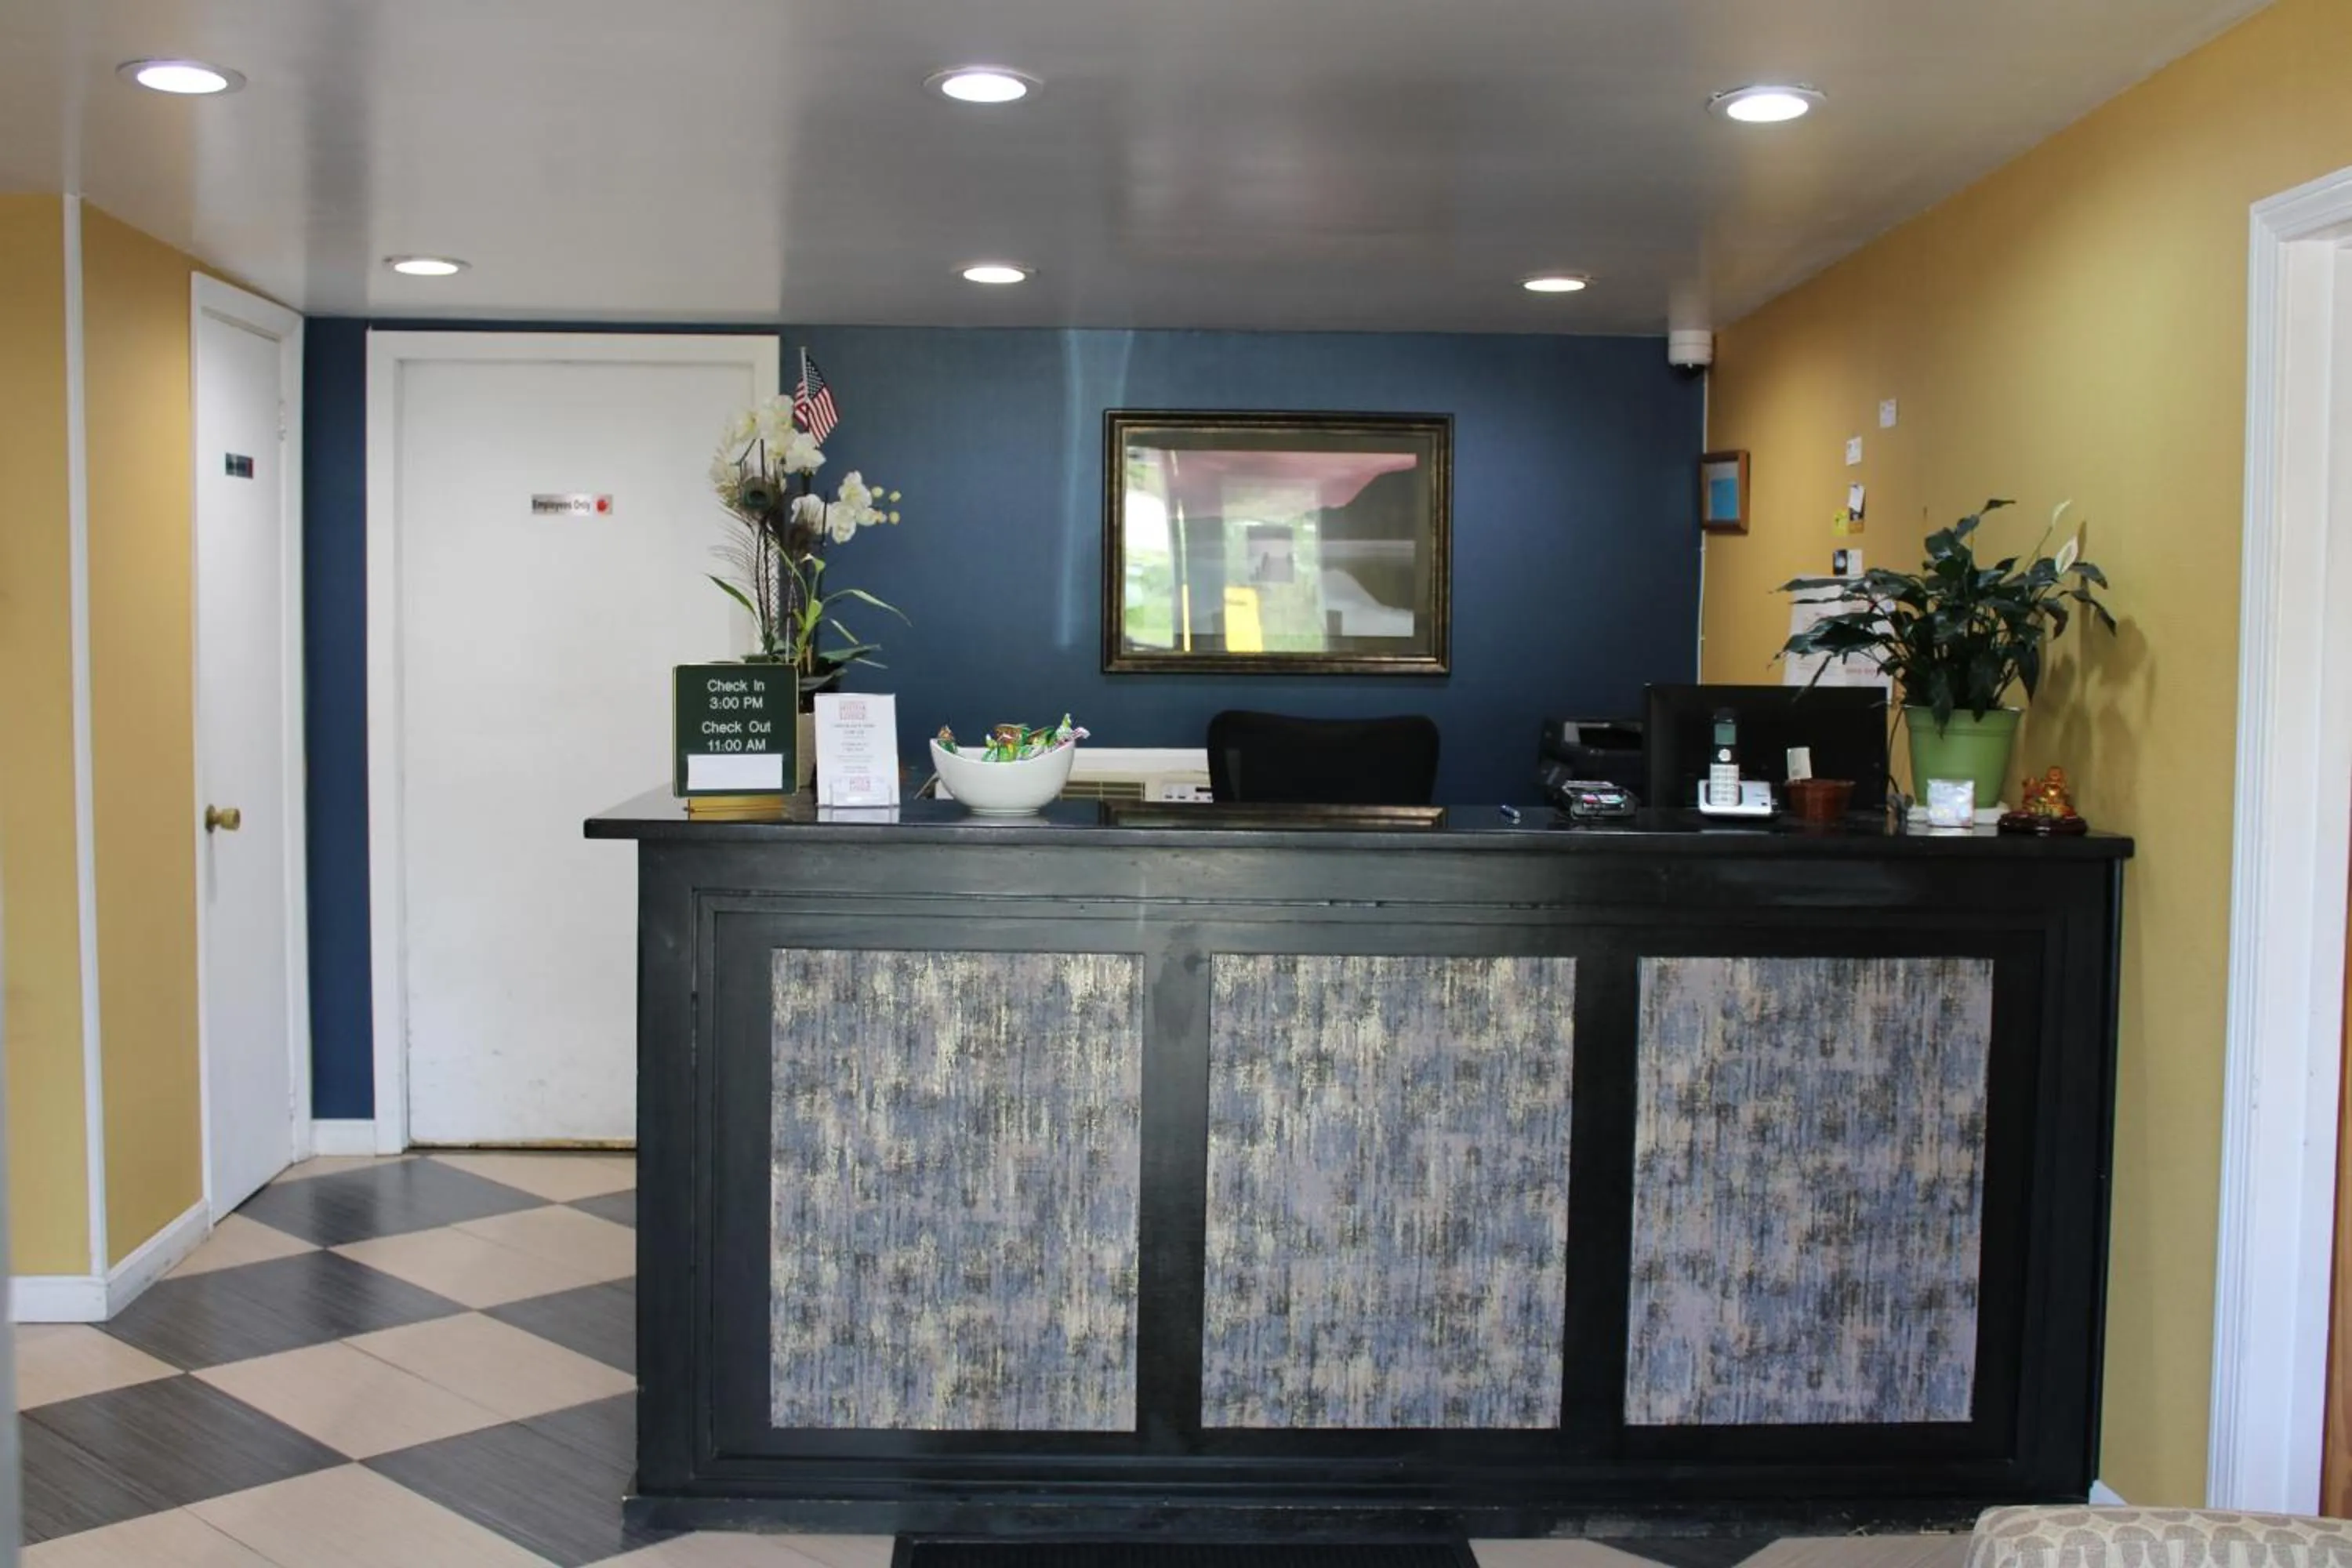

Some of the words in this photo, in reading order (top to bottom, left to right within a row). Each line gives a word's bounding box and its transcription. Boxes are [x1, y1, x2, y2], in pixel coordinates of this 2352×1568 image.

[573, 499, 590, 512] Only
[707, 679, 748, 691] Check
[753, 679, 765, 691] In
[709, 696, 739, 709] 3:00
[743, 696, 764, 709] PM
[702, 720, 742, 734] Check
[749, 720, 771, 733] Out
[707, 739, 742, 752] 11:00
[746, 739, 766, 751] AM
